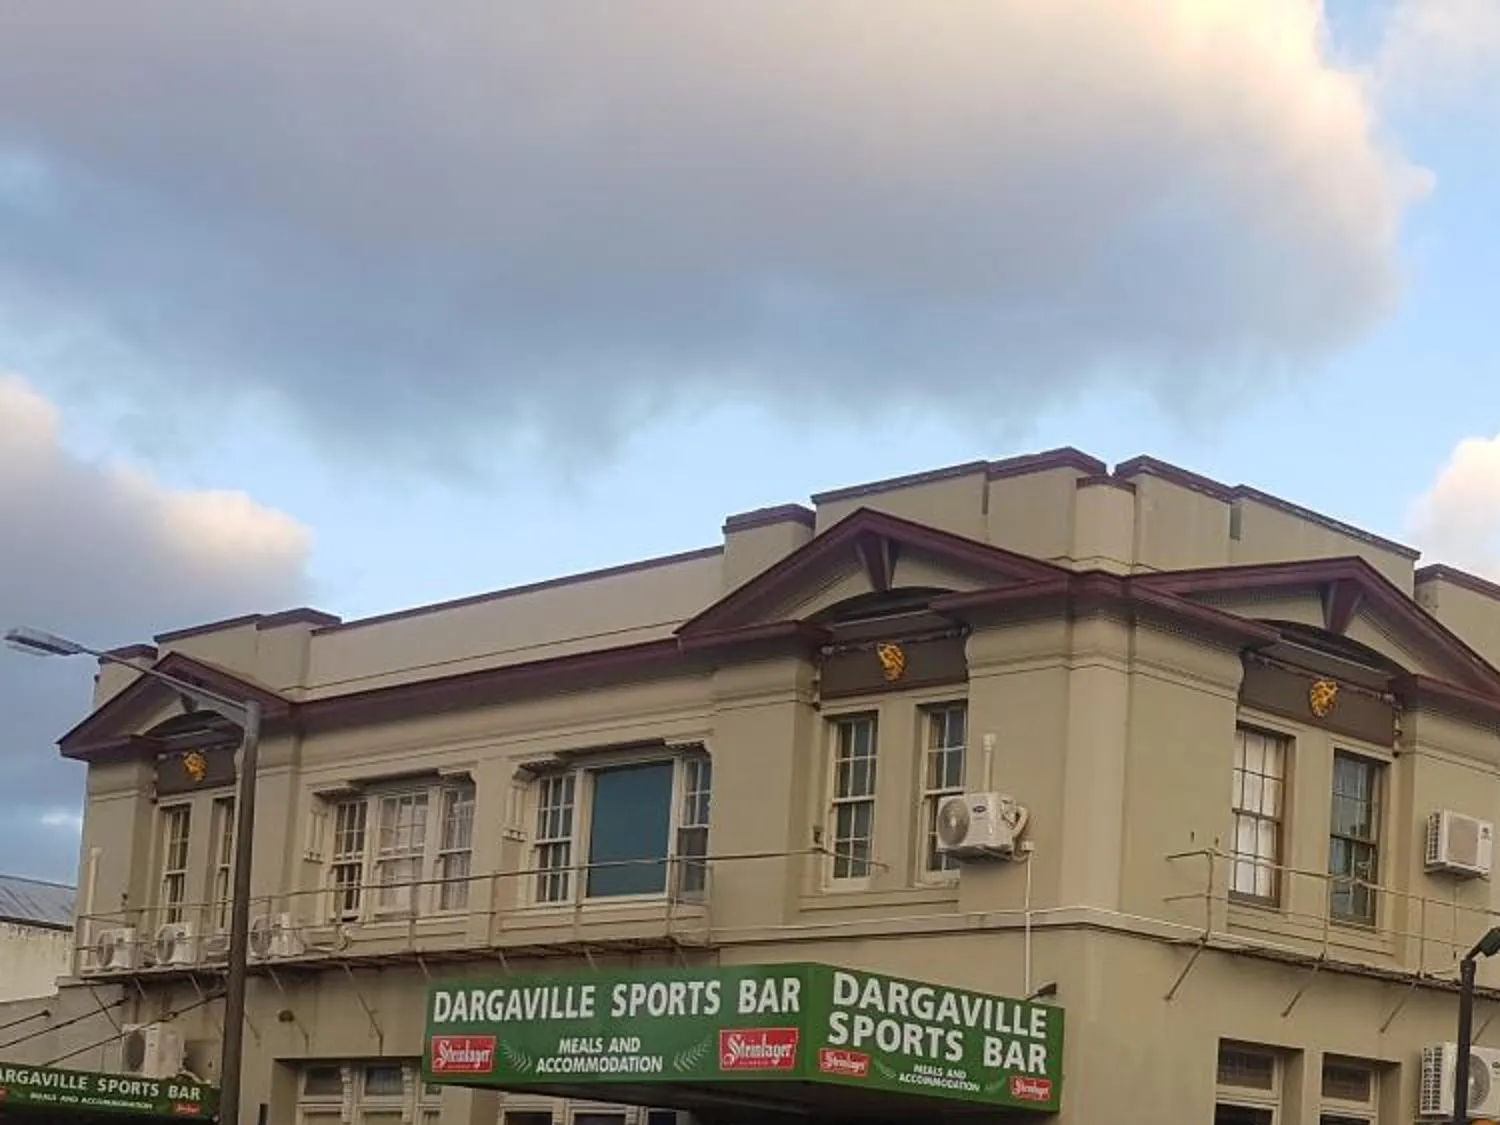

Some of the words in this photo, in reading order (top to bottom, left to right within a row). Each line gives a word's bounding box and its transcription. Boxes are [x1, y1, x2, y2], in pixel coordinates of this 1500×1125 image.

[433, 985, 596, 1024] DARGAVILLE
[611, 980, 721, 1018] SPORTS
[738, 977, 801, 1014] BAR
[833, 971, 1048, 1039] DARGAVILLE
[559, 1038, 603, 1054] MEALS
[608, 1037, 641, 1053] AND
[724, 1032, 794, 1066] Steinlager
[828, 1011, 964, 1063] SPORTS
[983, 1036, 1048, 1075] BAR
[536, 1056, 663, 1074] ACCOMMODATION
[913, 1064, 943, 1077] MEALS
[947, 1069, 967, 1080] AND
[97, 1077, 160, 1098] SPORTS
[168, 1085, 201, 1101] BAR
[899, 1073, 981, 1092] ACCOMMODATION
